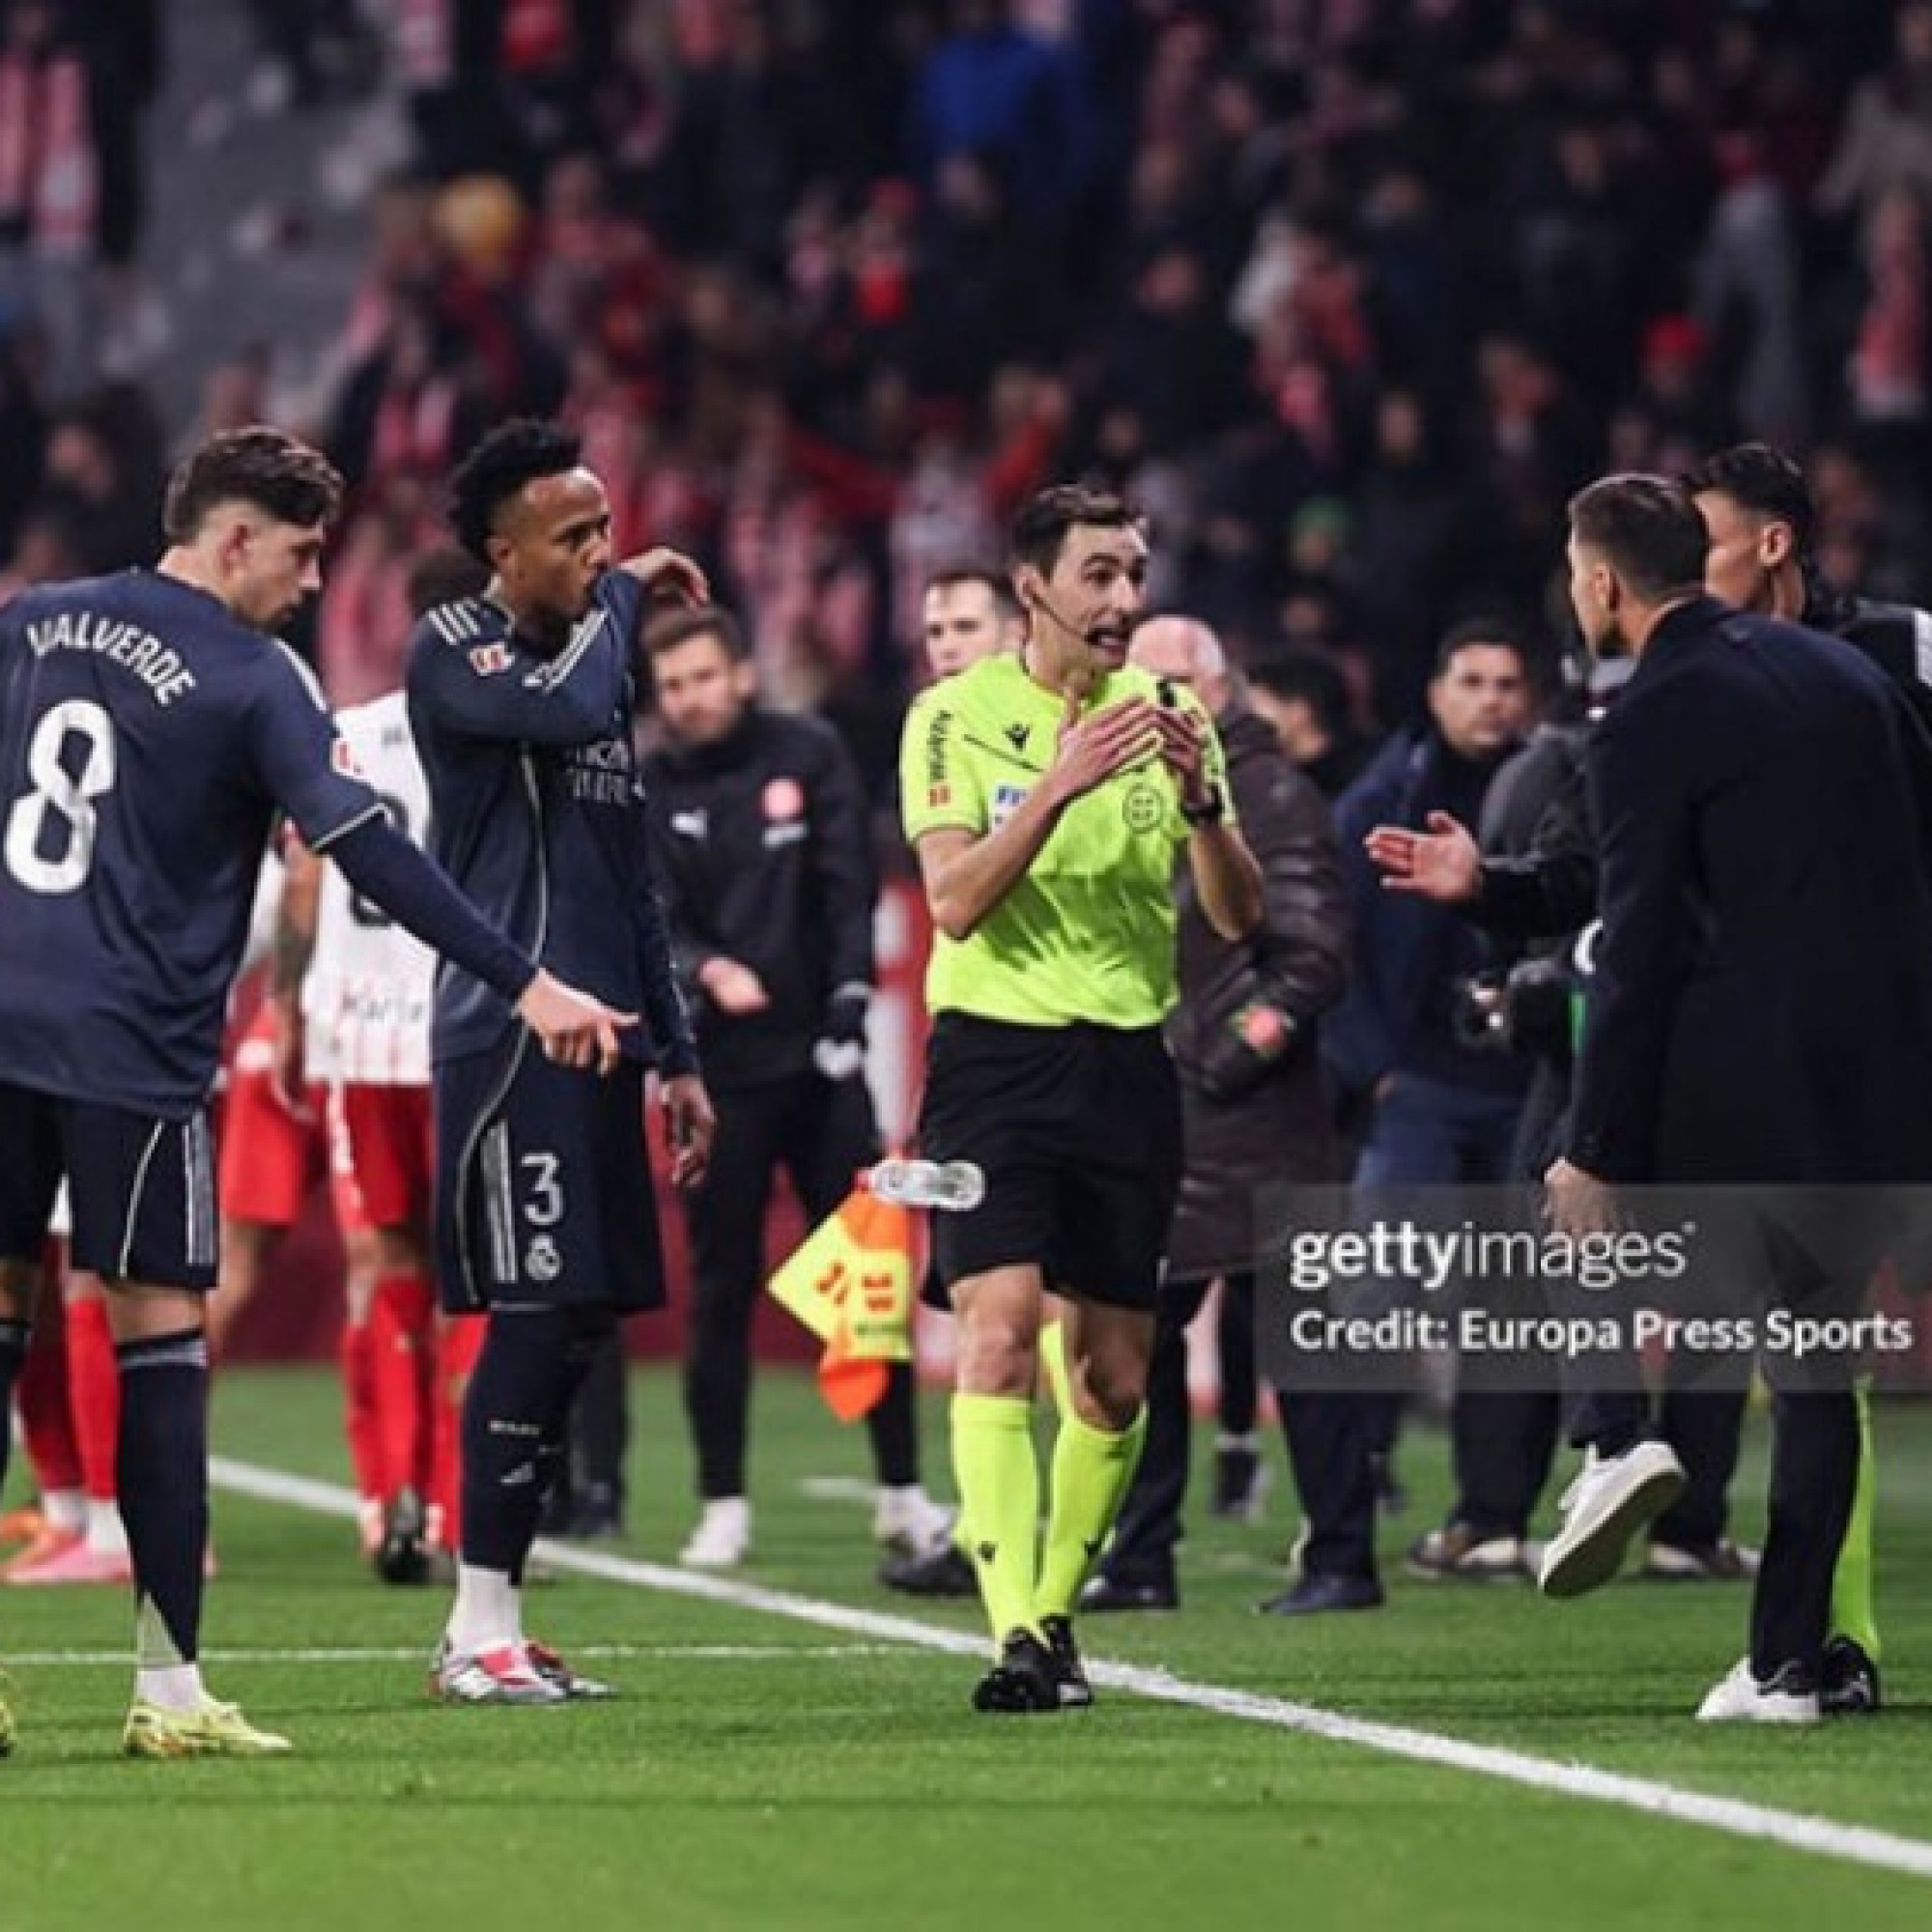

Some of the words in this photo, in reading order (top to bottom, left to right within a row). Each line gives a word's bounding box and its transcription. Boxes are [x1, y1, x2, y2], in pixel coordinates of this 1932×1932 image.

[26, 610, 197, 706] VALVERDE
[4, 698, 116, 895] 8
[521, 1151, 564, 1226] 3
